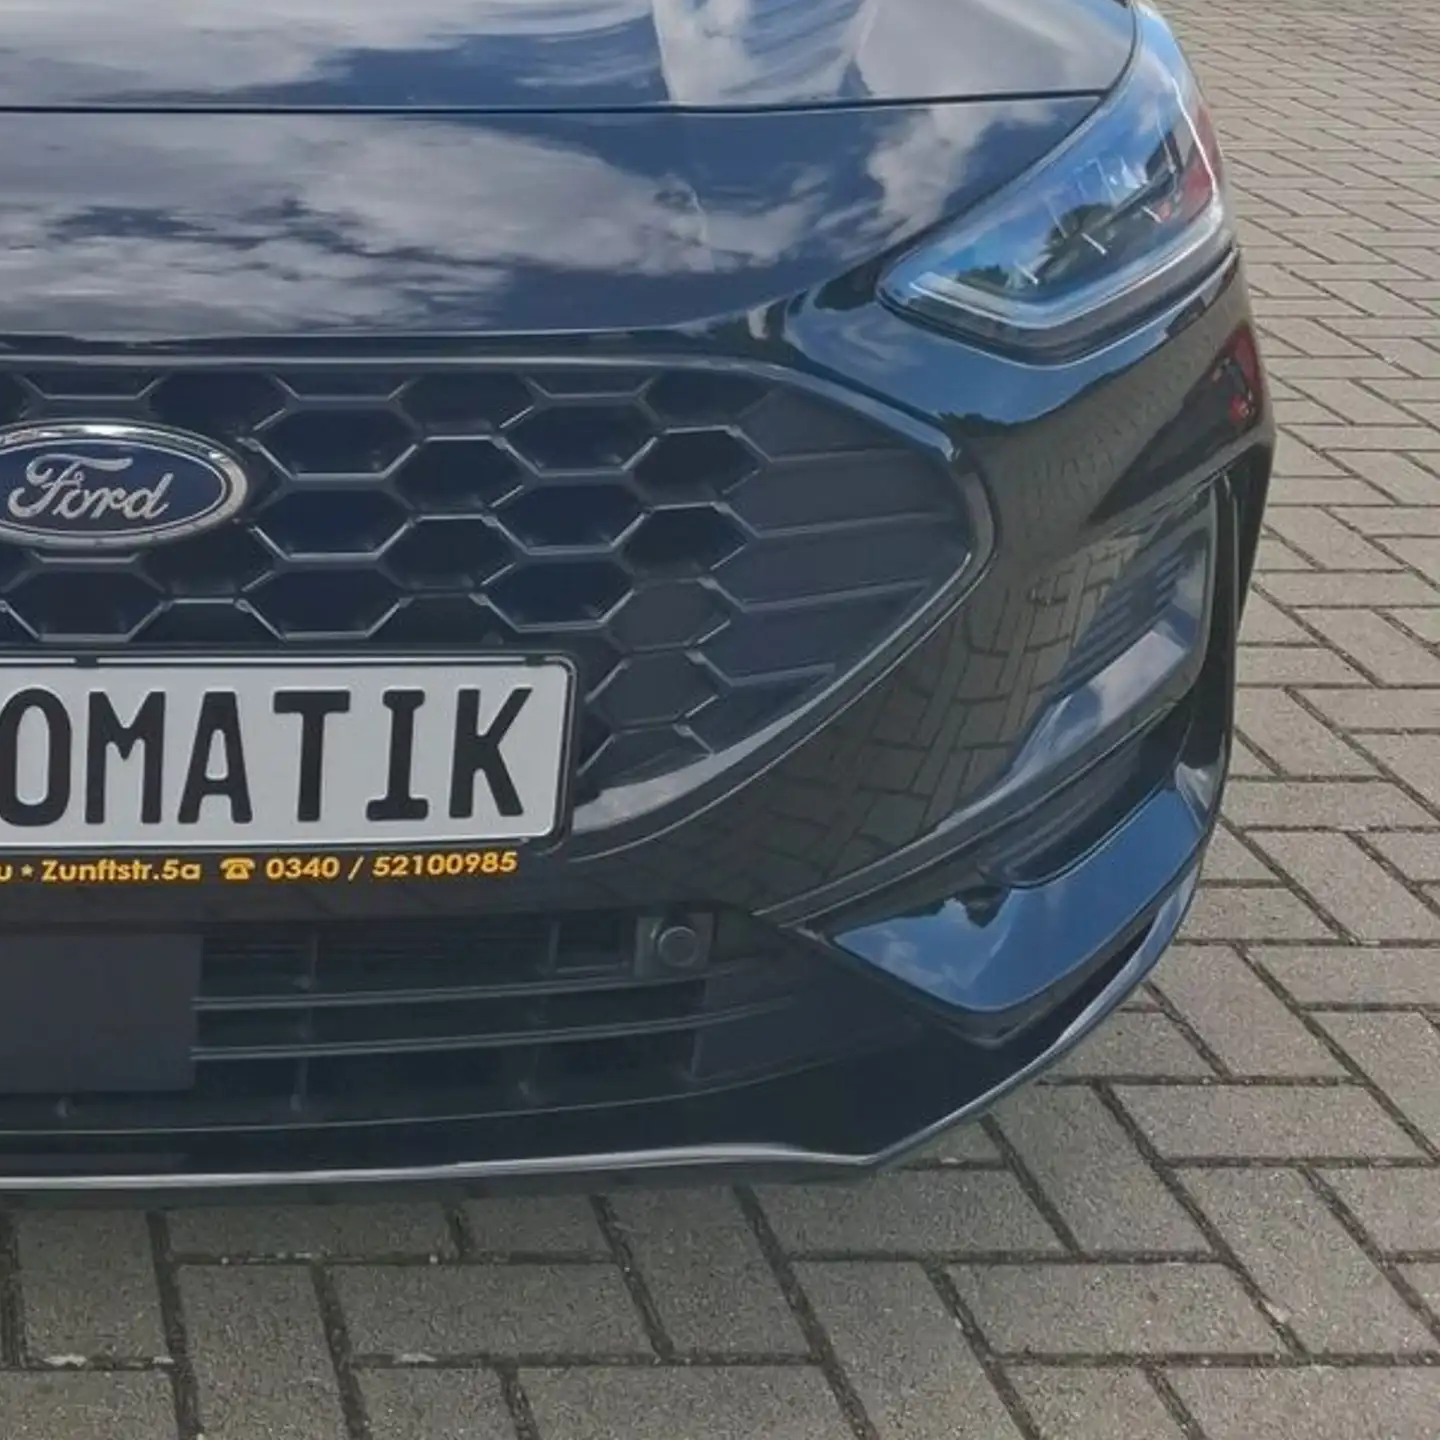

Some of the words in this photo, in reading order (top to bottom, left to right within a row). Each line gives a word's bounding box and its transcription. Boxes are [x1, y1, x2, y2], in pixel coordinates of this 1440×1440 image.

[8, 453, 174, 520] Ford
[41, 859, 202, 883] Zunftstr.5a
[265, 857, 341, 881] 0340
[371, 850, 518, 878] 52100985
